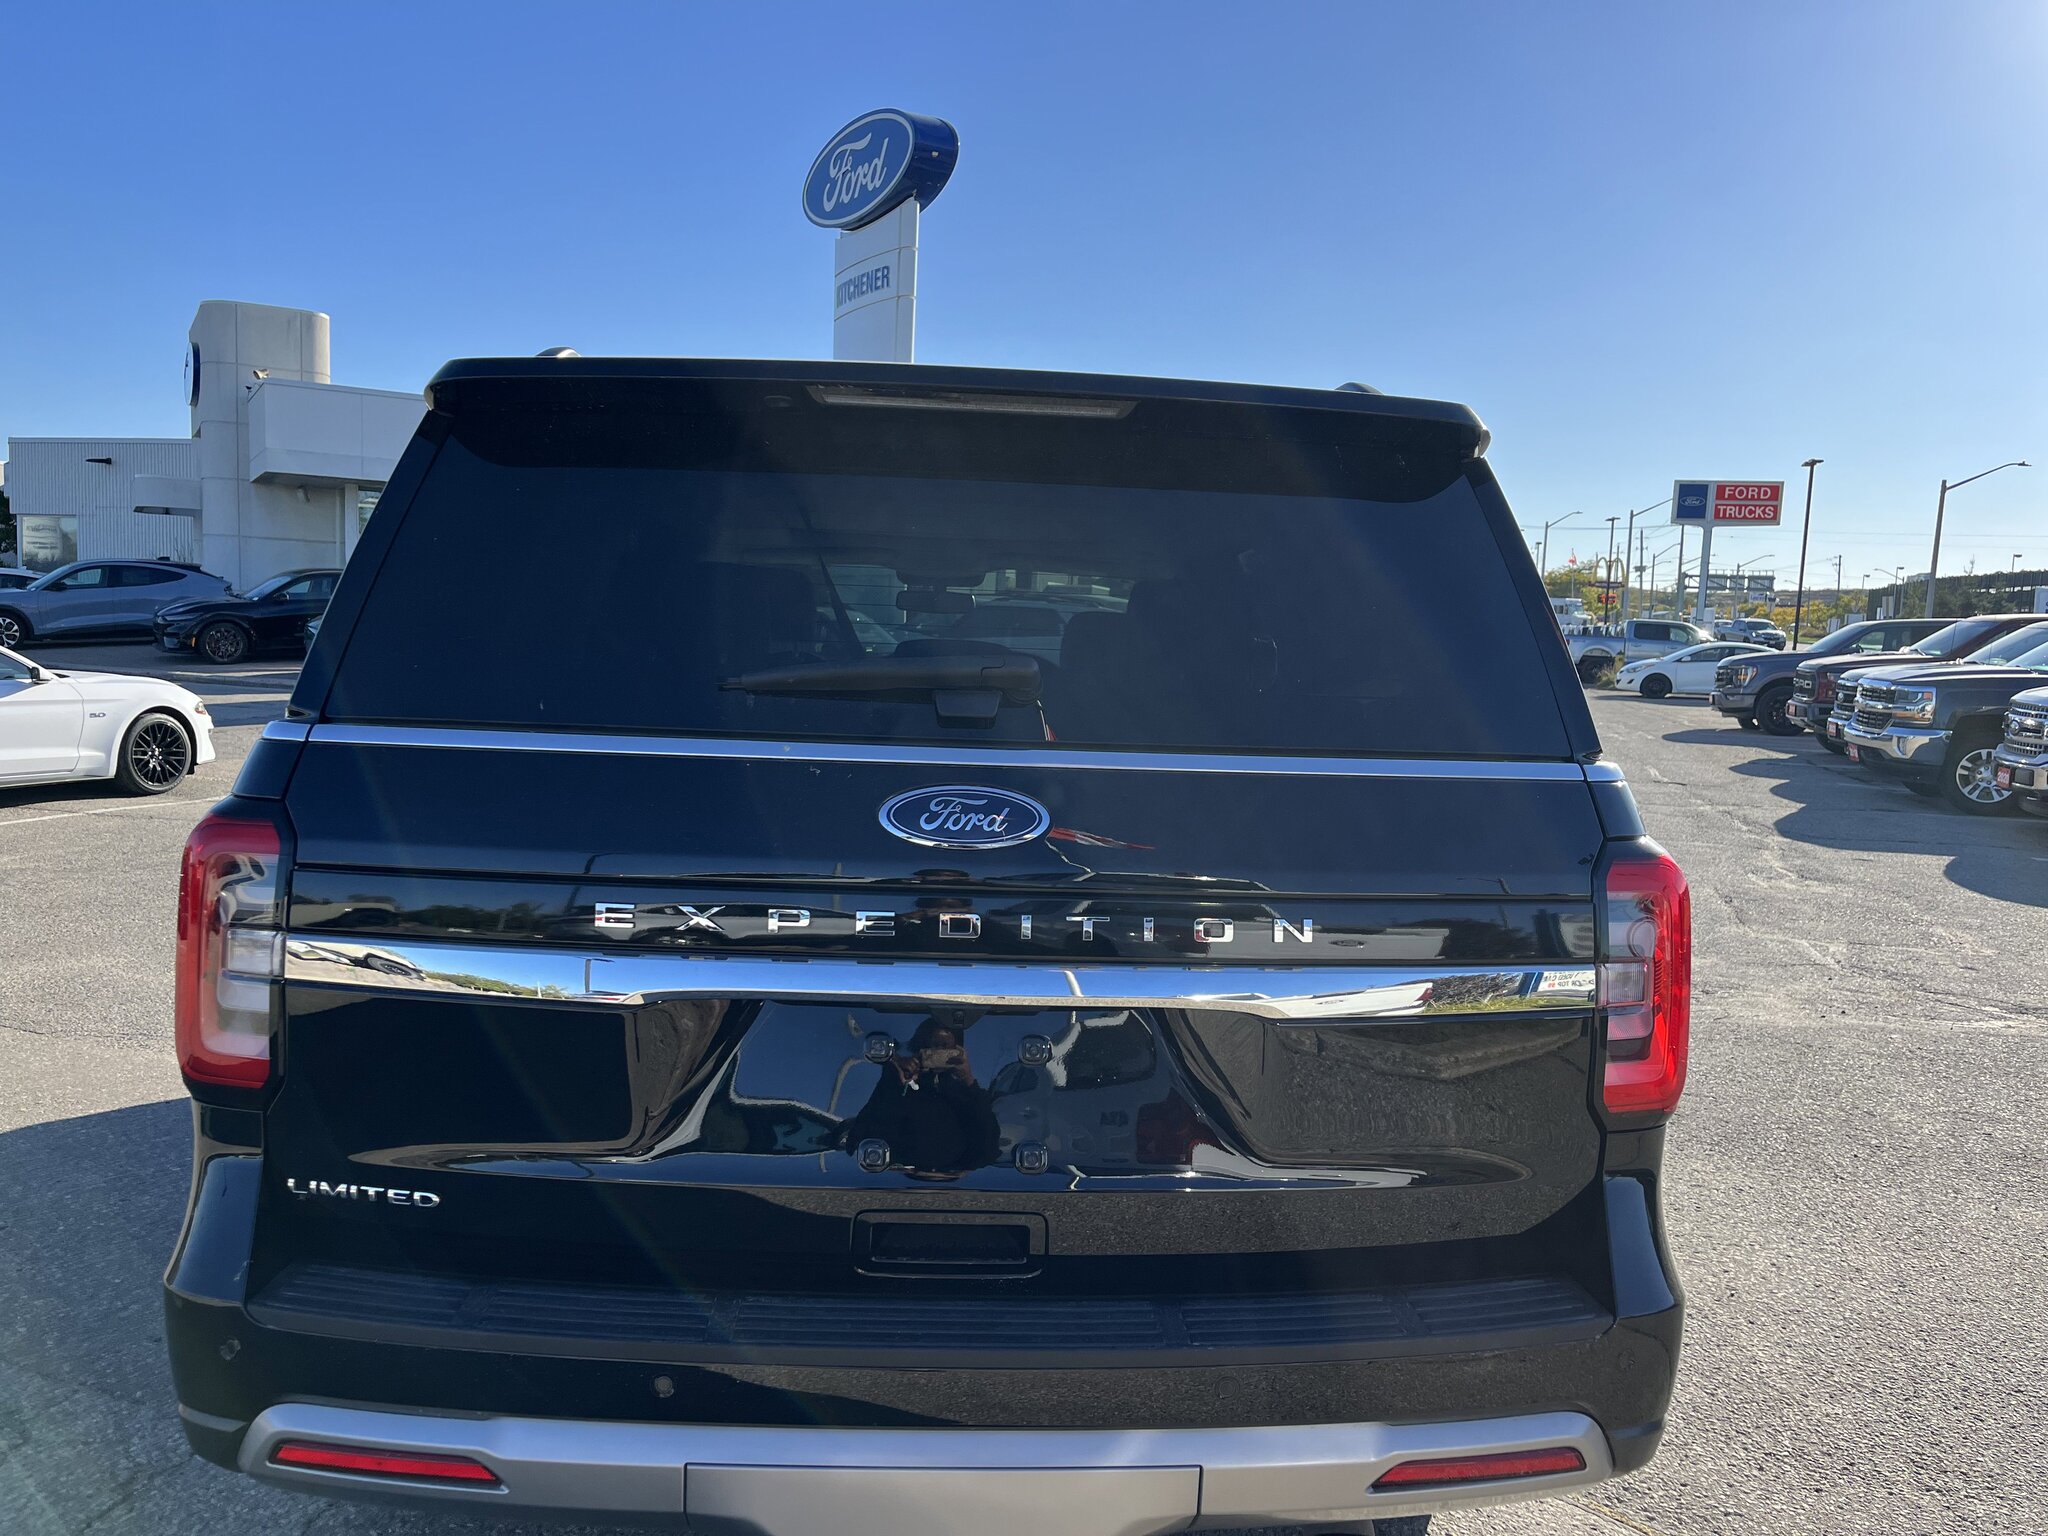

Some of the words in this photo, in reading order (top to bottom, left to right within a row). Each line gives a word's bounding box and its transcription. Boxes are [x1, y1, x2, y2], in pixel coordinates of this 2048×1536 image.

[823, 132, 889, 212] Ford
[836, 265, 890, 309] KITCHENER
[1724, 486, 1771, 500] FORD
[1717, 505, 1774, 519] TRUCKS
[919, 796, 1011, 832] Ford
[594, 902, 1314, 944] EXPEDITION
[287, 1178, 440, 1208] LIMITED
